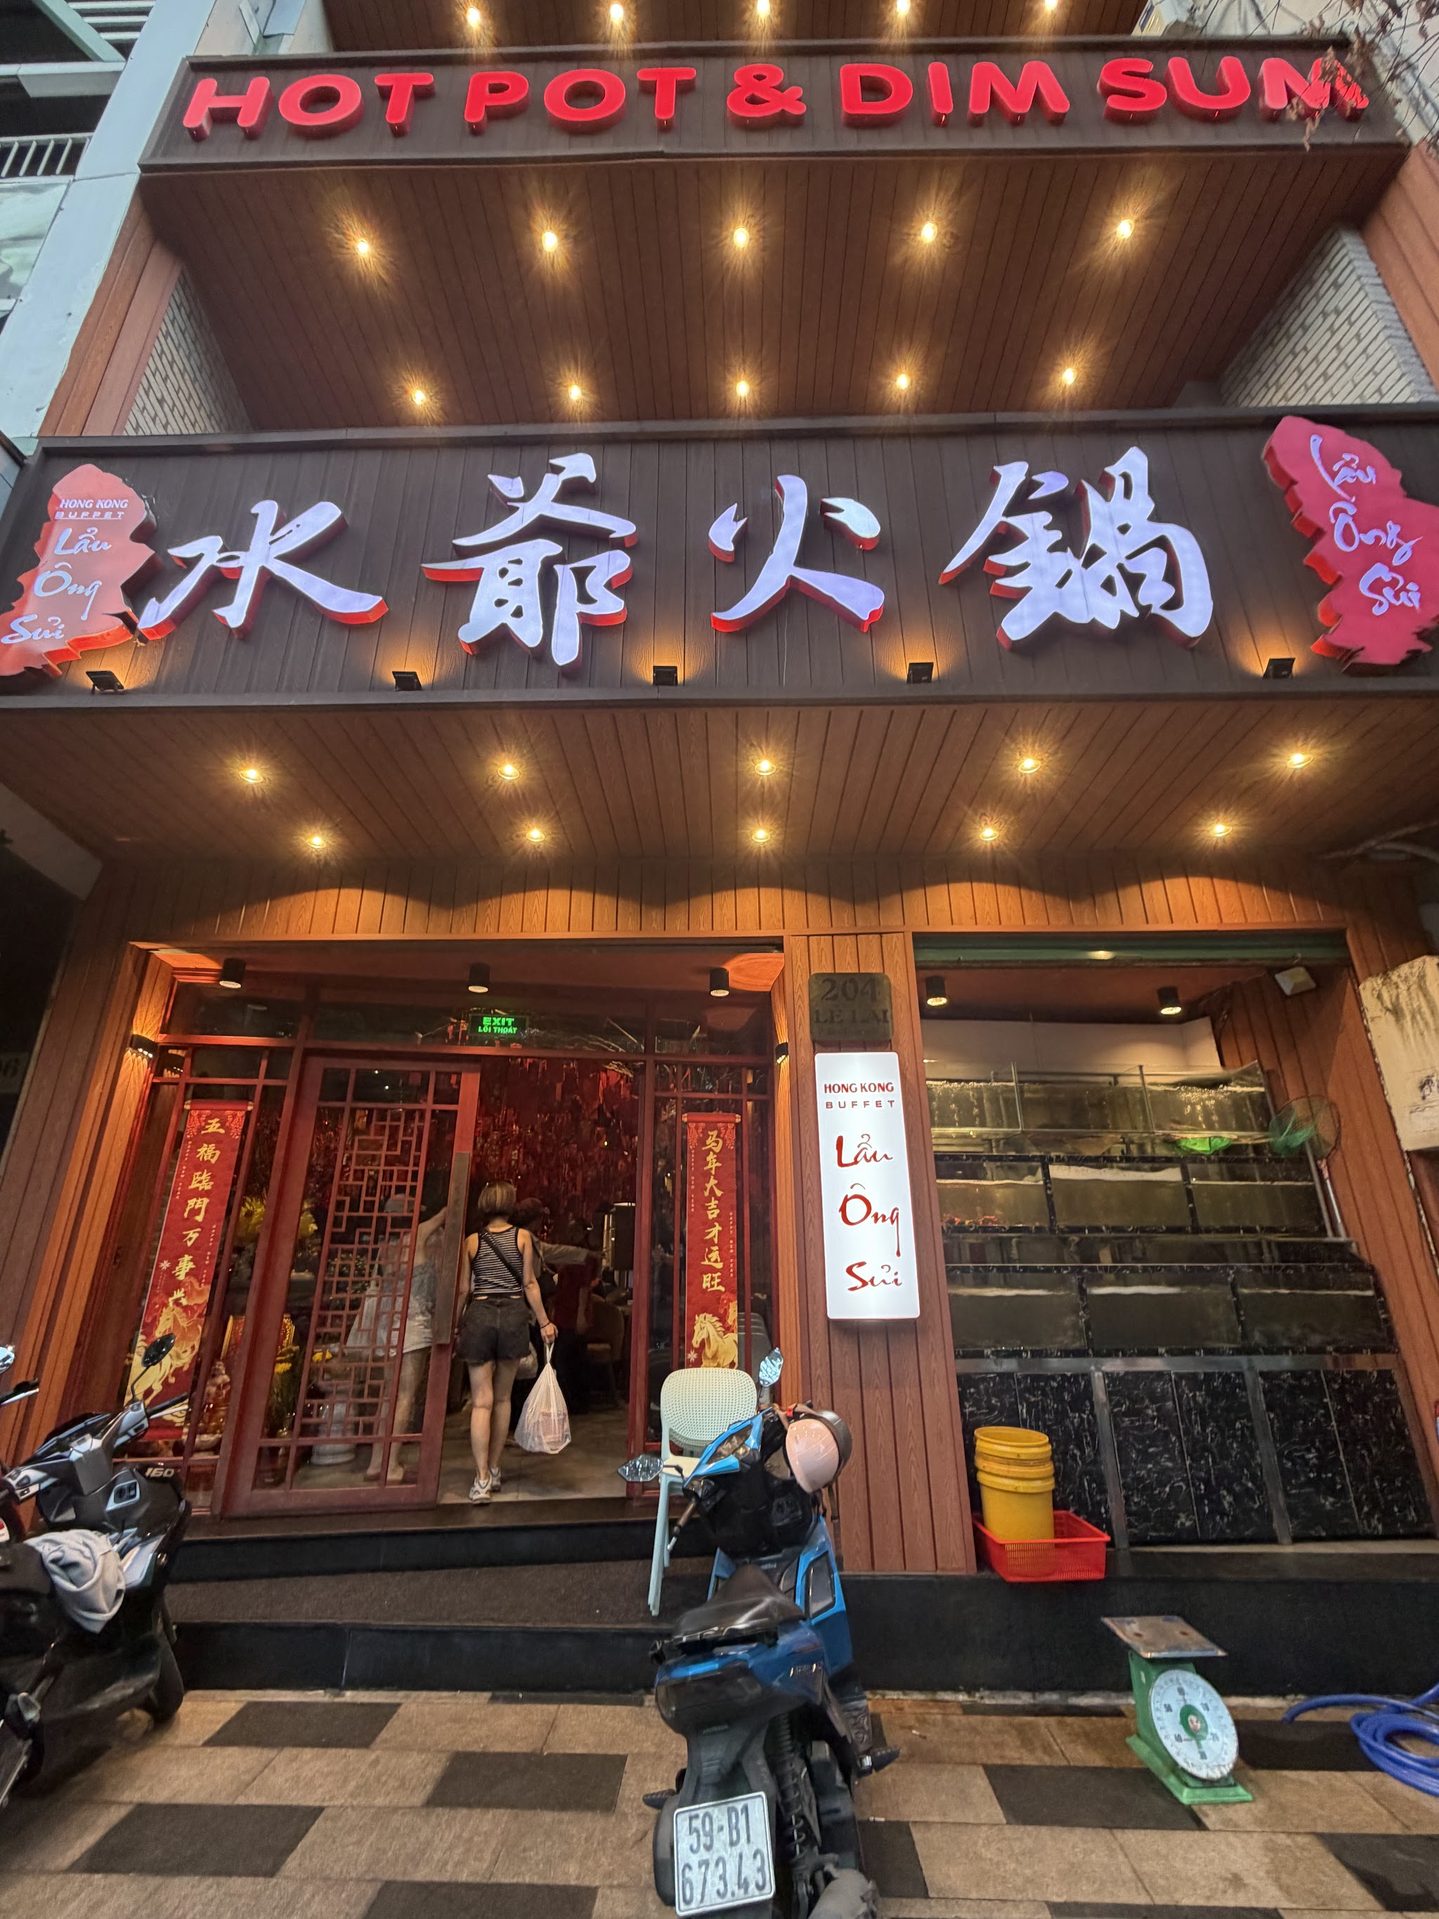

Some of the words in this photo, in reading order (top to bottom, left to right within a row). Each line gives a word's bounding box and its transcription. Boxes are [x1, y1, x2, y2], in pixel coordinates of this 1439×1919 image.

[183, 73, 434, 139] HOT
[464, 67, 697, 134] POT
[726, 63, 806, 126] &
[840, 60, 1071, 124] DIM
[1099, 56, 1369, 121] SUN
[54, 511, 125, 519] BUFFET
[59, 499, 93, 508] HONG
[96, 499, 128, 508] KONG
[54, 527, 113, 556] Lẩu
[34, 561, 103, 621] Ông
[1, 614, 65, 644] Sủi
[482, 1016, 515, 1027] EXIT
[824, 1083, 858, 1094] HONG
[860, 1082, 894, 1093] KONG
[825, 1100, 895, 1109] BUFFET
[835, 1133, 893, 1168] Lẩu
[838, 1182, 900, 1257] Ông
[845, 1261, 903, 1292] Sủi
[145, 1467, 174, 1478] 160
[688, 1803, 751, 1854] 59-B1
[681, 1848, 767, 1906] 673.43
